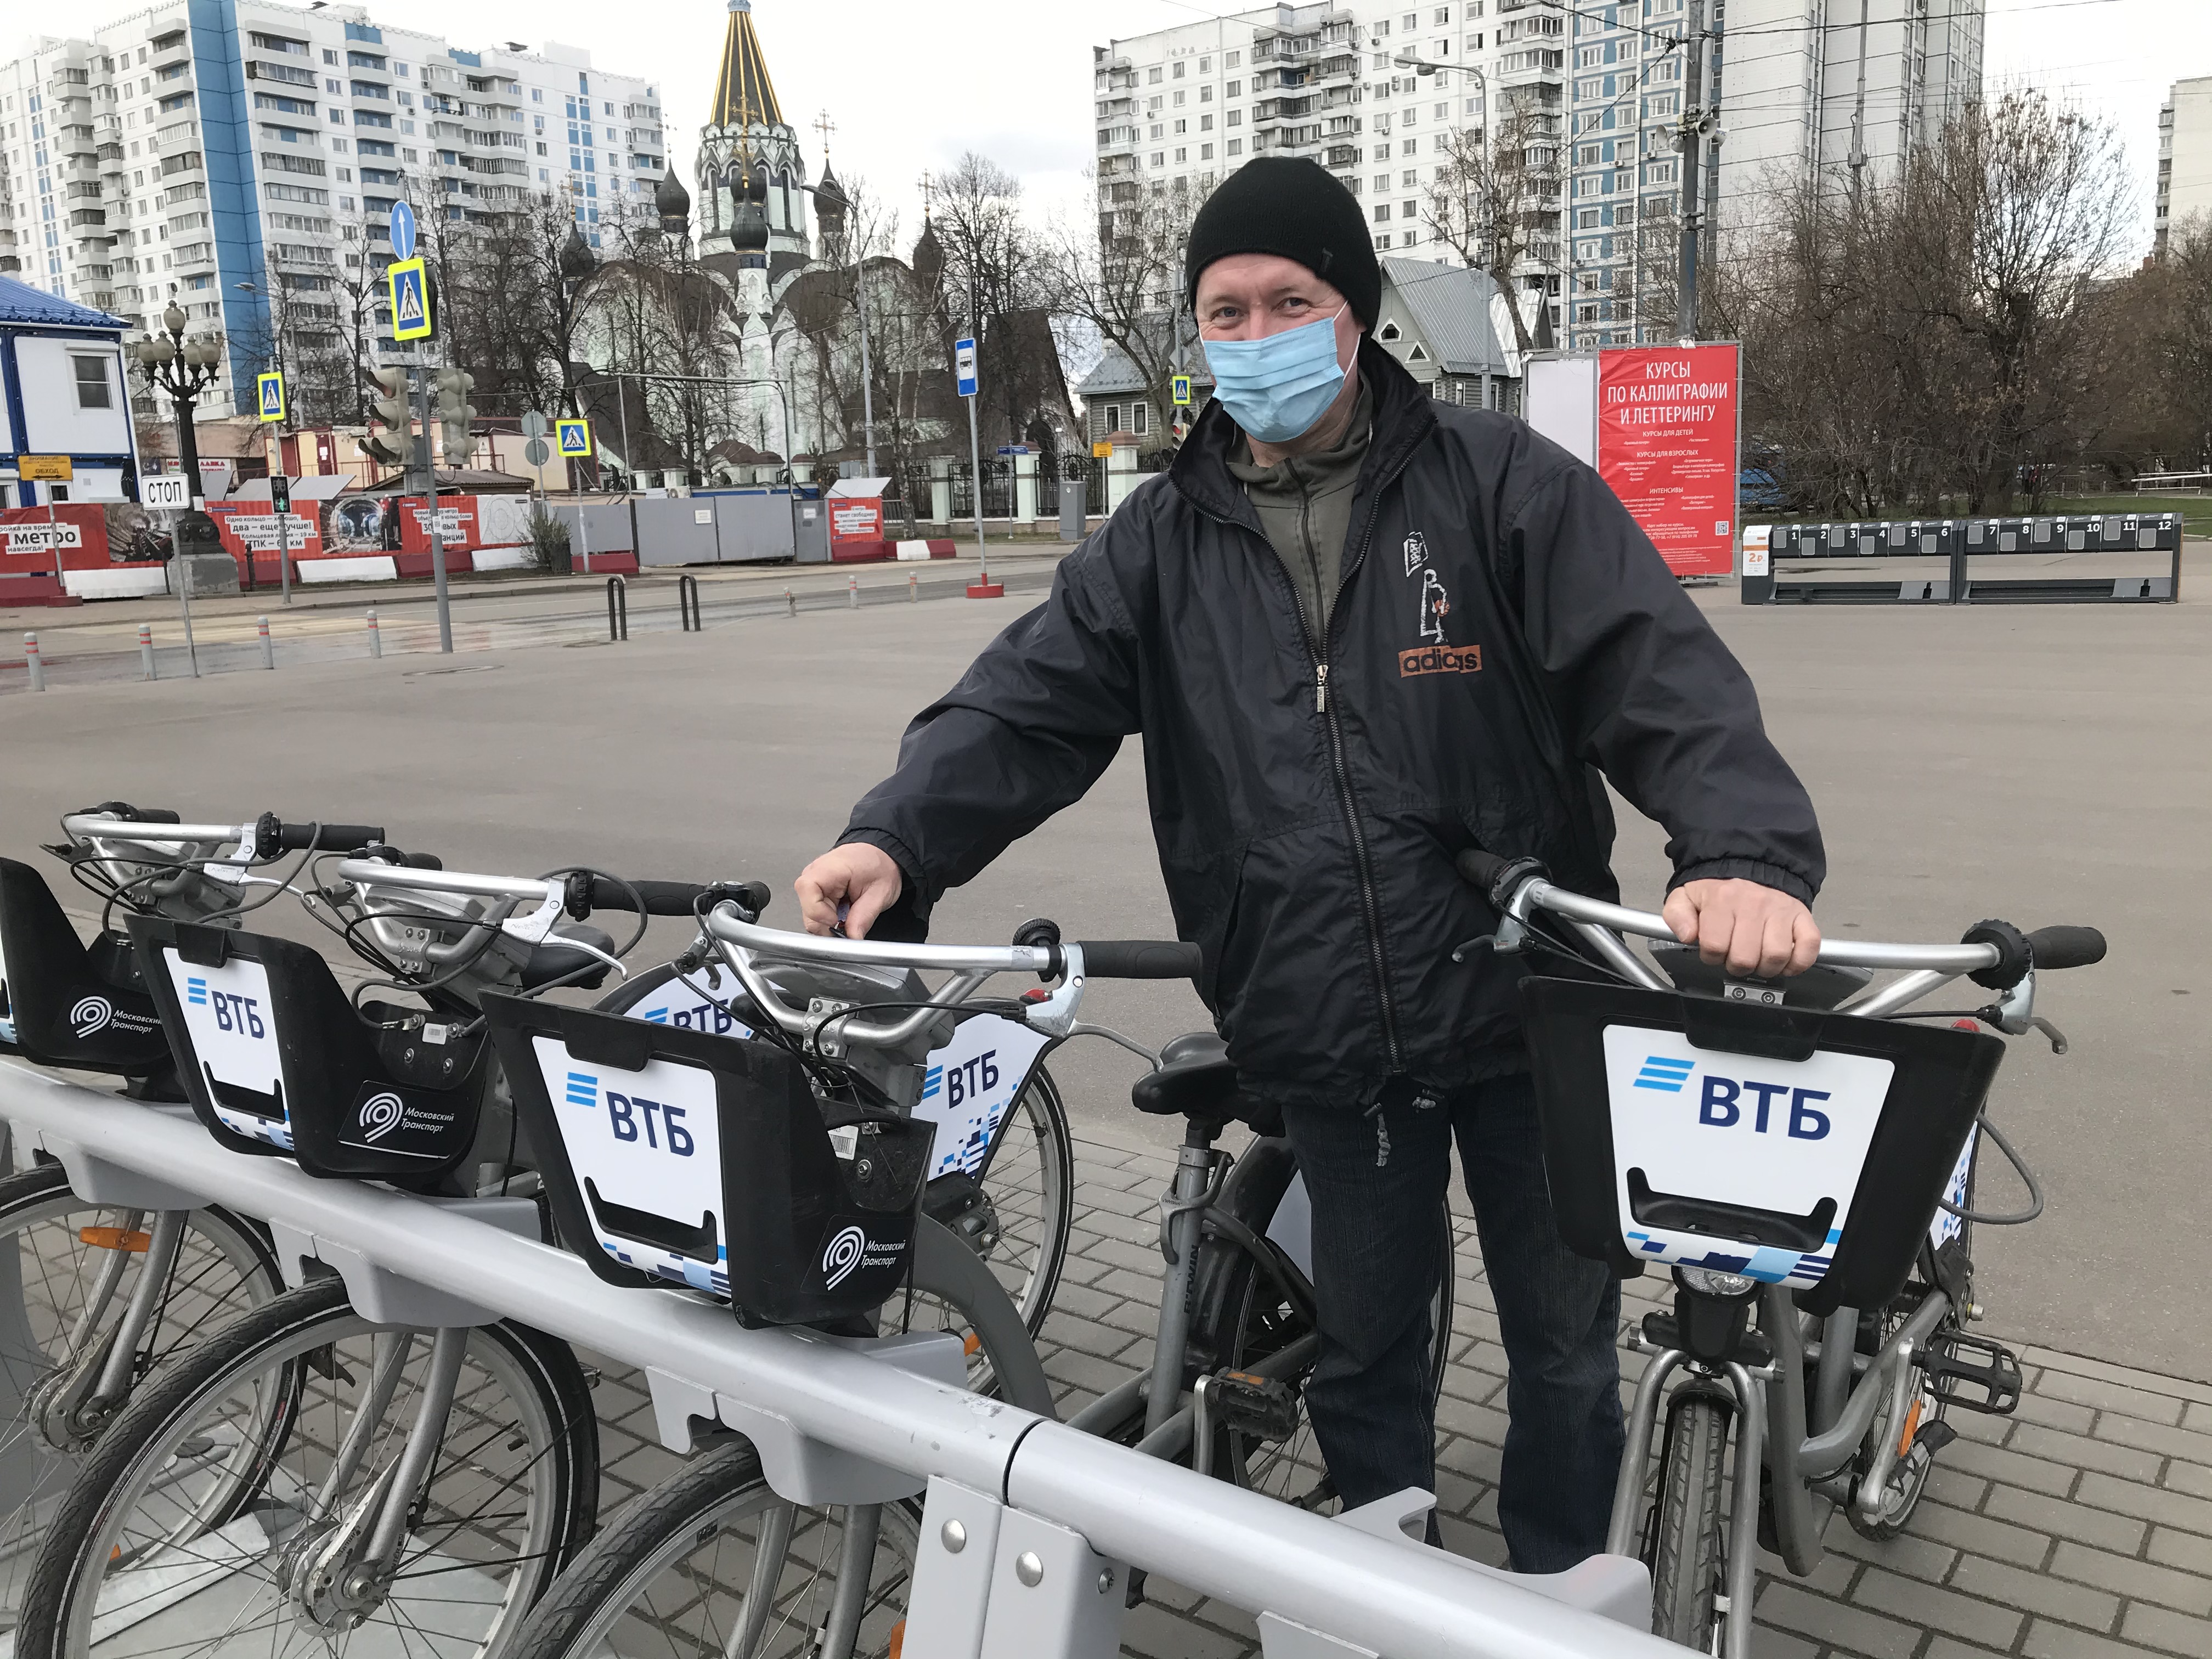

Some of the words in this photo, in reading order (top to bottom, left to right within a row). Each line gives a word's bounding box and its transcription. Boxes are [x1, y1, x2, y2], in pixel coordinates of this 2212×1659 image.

[1646, 361, 1691, 379] КУРСЫ
[1607, 386, 1626, 403] ПО
[1630, 382, 1728, 402] КАЛЛИГРАФИИ
[1620, 408, 1629, 425] И
[1633, 405, 1716, 424] ЛЕТТЕРИНГУ
[149, 481, 182, 503] СТОП
[284, 522, 311, 532] учше!
[1989, 526, 1996, 535] 7
[2022, 525, 2029, 534] 8
[2057, 524, 2064, 533] 9
[2086, 523, 2100, 532] 10
[2123, 522, 2136, 531] 11
[2158, 521, 2171, 530] 12
[442, 533, 465, 541] анций
[1792, 532, 1797, 540] 1
[1911, 529, 1917, 537] 5
[1941, 528, 1948, 537] 6
[247, 540, 266, 548] ТПК
[212, 990, 265, 1039] ВТБ
[673, 998, 732, 1034] ВТБ
[110, 1018, 153, 1034] Транспорт
[947, 1049, 998, 1109] ВТБ
[405, 1106, 454, 1122] Московский
[1699, 1075, 1831, 1141] ВТБ
[401, 1119, 443, 1134] Транспорт
[606, 1091, 695, 1157] ВТБ
[865, 1239, 906, 1251] Московский
[861, 1254, 896, 1269] Транспорт
